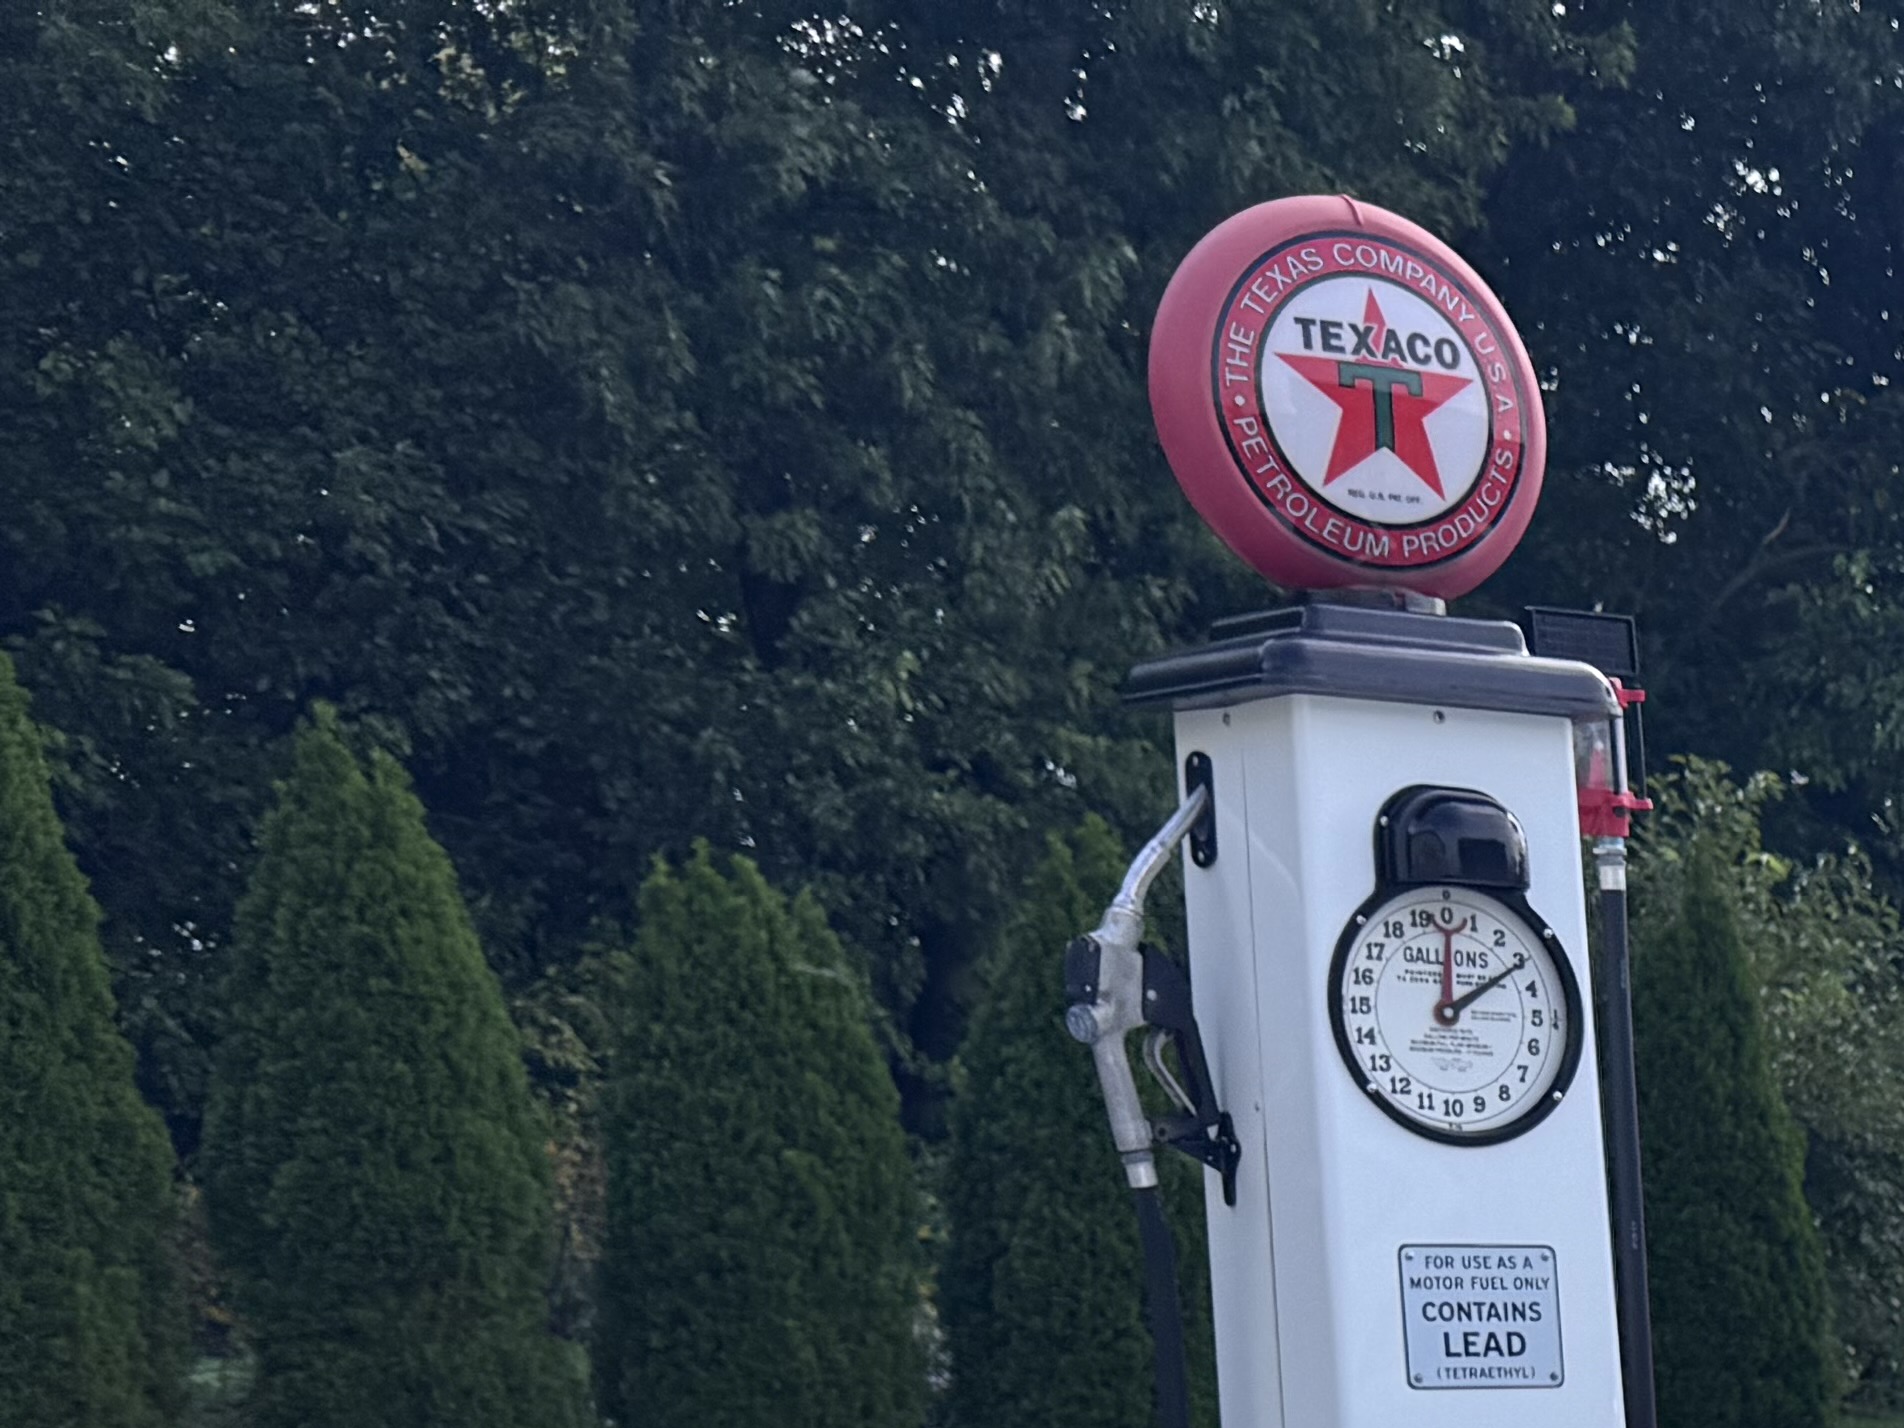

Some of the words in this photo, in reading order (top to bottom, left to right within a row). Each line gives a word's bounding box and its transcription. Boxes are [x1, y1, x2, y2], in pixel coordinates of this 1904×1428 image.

[1225, 321, 1255, 387] THE
[1240, 248, 1324, 315] TEXAS
[1333, 243, 1475, 322] COMPANY
[1293, 316, 1461, 370] TEXACO
[1337, 361, 1424, 450] T
[1233, 416, 1390, 560] PETROLEUM
[1402, 448, 1514, 559] PRODUCTS
[1440, 907, 1453, 925] 0
[1470, 913, 1478, 933] 1
[1383, 920, 1405, 939] 18
[1493, 929, 1506, 947] 2
[1366, 942, 1385, 961] 17
[1403, 946, 1489, 969] GALLONS
[1512, 952, 1525, 970] 3
[1353, 967, 1374, 986] 16
[1525, 980, 1538, 998] 4
[1350, 996, 1372, 1015] 15
[1531, 1009, 1544, 1027] 5
[1355, 1026, 1377, 1046] 14
[1527, 1038, 1540, 1056] 6
[1369, 1054, 1392, 1072] 13
[1517, 1064, 1529, 1083] 7
[1390, 1076, 1412, 1095] 12
[1498, 1084, 1511, 1102] 8
[1418, 1092, 1435, 1111] 11
[1443, 1098, 1464, 1117] 10
[1473, 1096, 1486, 1113] 9
[1425, 1256, 1454, 1269] FOR
[1462, 1256, 1492, 1270] USE
[1497, 1256, 1516, 1270] AS
[1523, 1256, 1533, 1270] A
[1409, 1277, 1464, 1291] MOTOR
[1471, 1277, 1508, 1290] FUEL
[1513, 1277, 1550, 1290] ONLY
[1421, 1301, 1543, 1323] CONTAINS
[1443, 1331, 1527, 1358] LEAD
